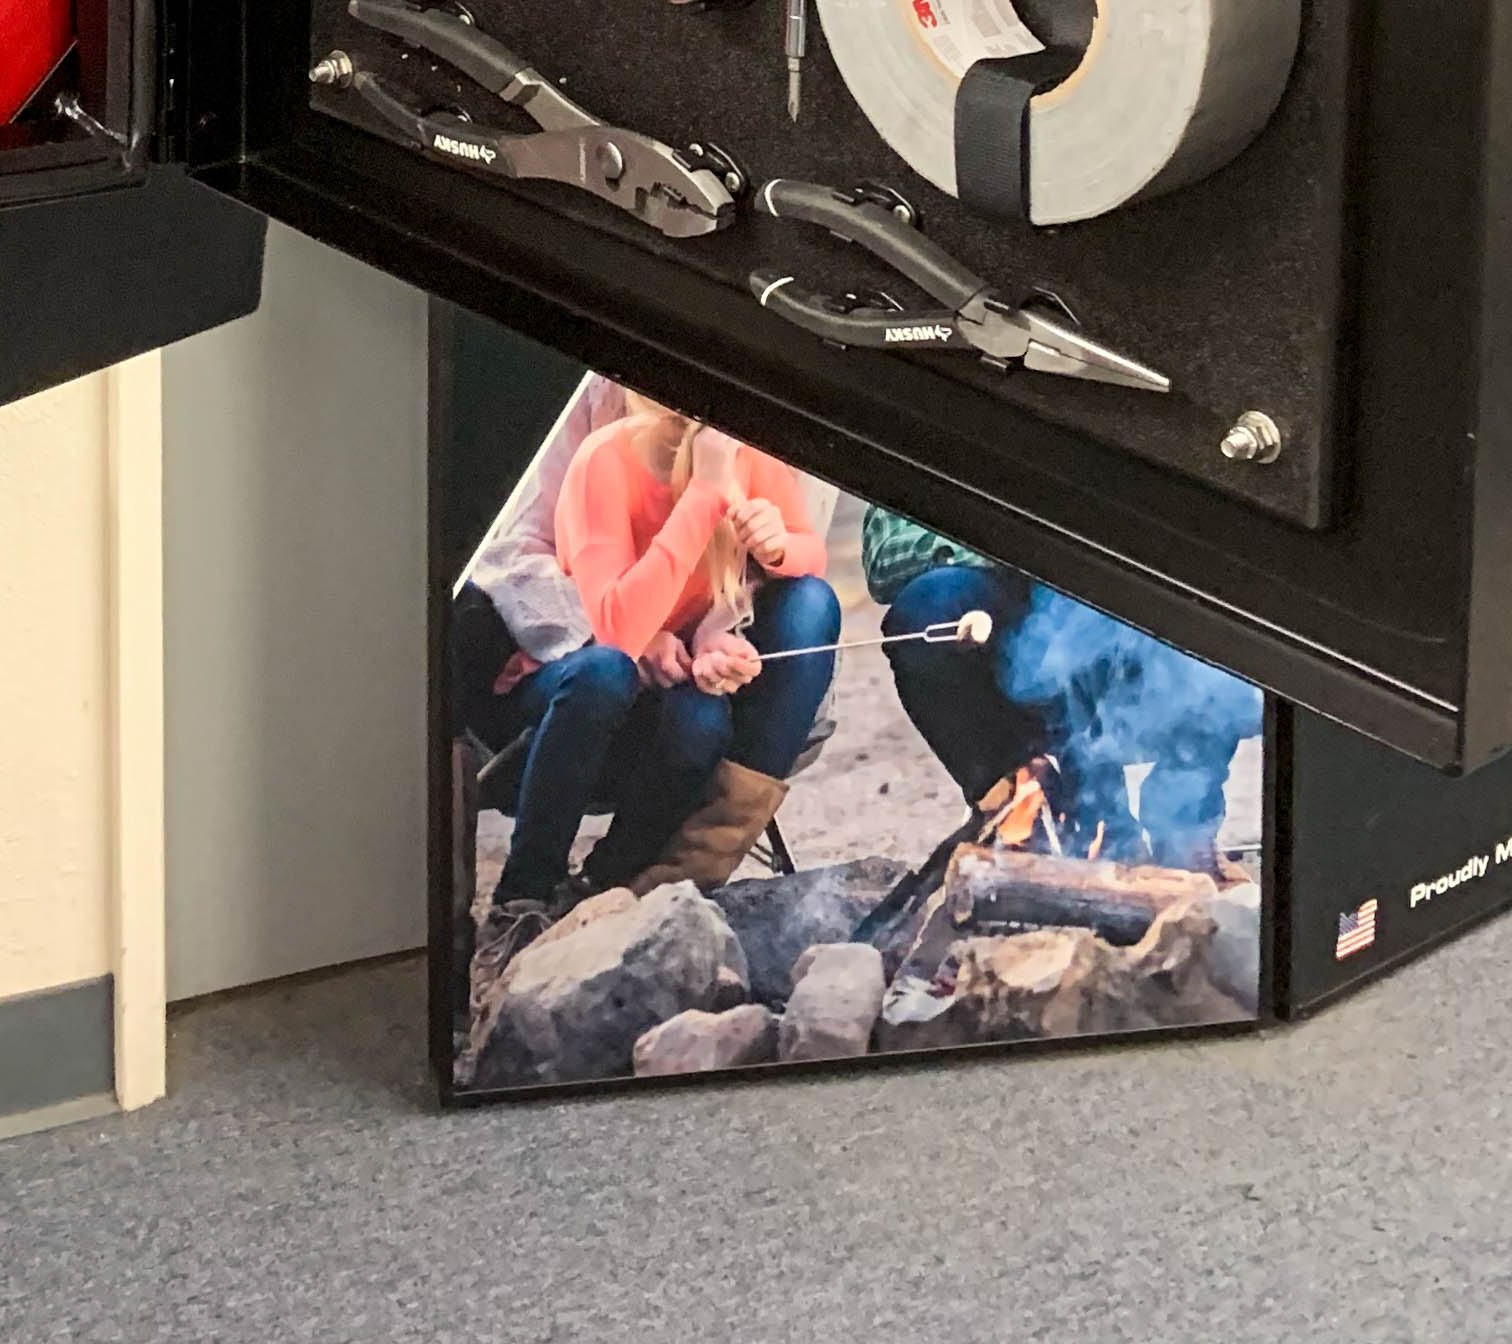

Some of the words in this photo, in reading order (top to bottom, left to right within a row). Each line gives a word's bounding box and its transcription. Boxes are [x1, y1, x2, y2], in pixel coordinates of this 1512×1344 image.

[434, 134, 480, 161] HUSKY
[885, 326, 936, 342] HUSKY
[1410, 855, 1489, 908] Proudly
